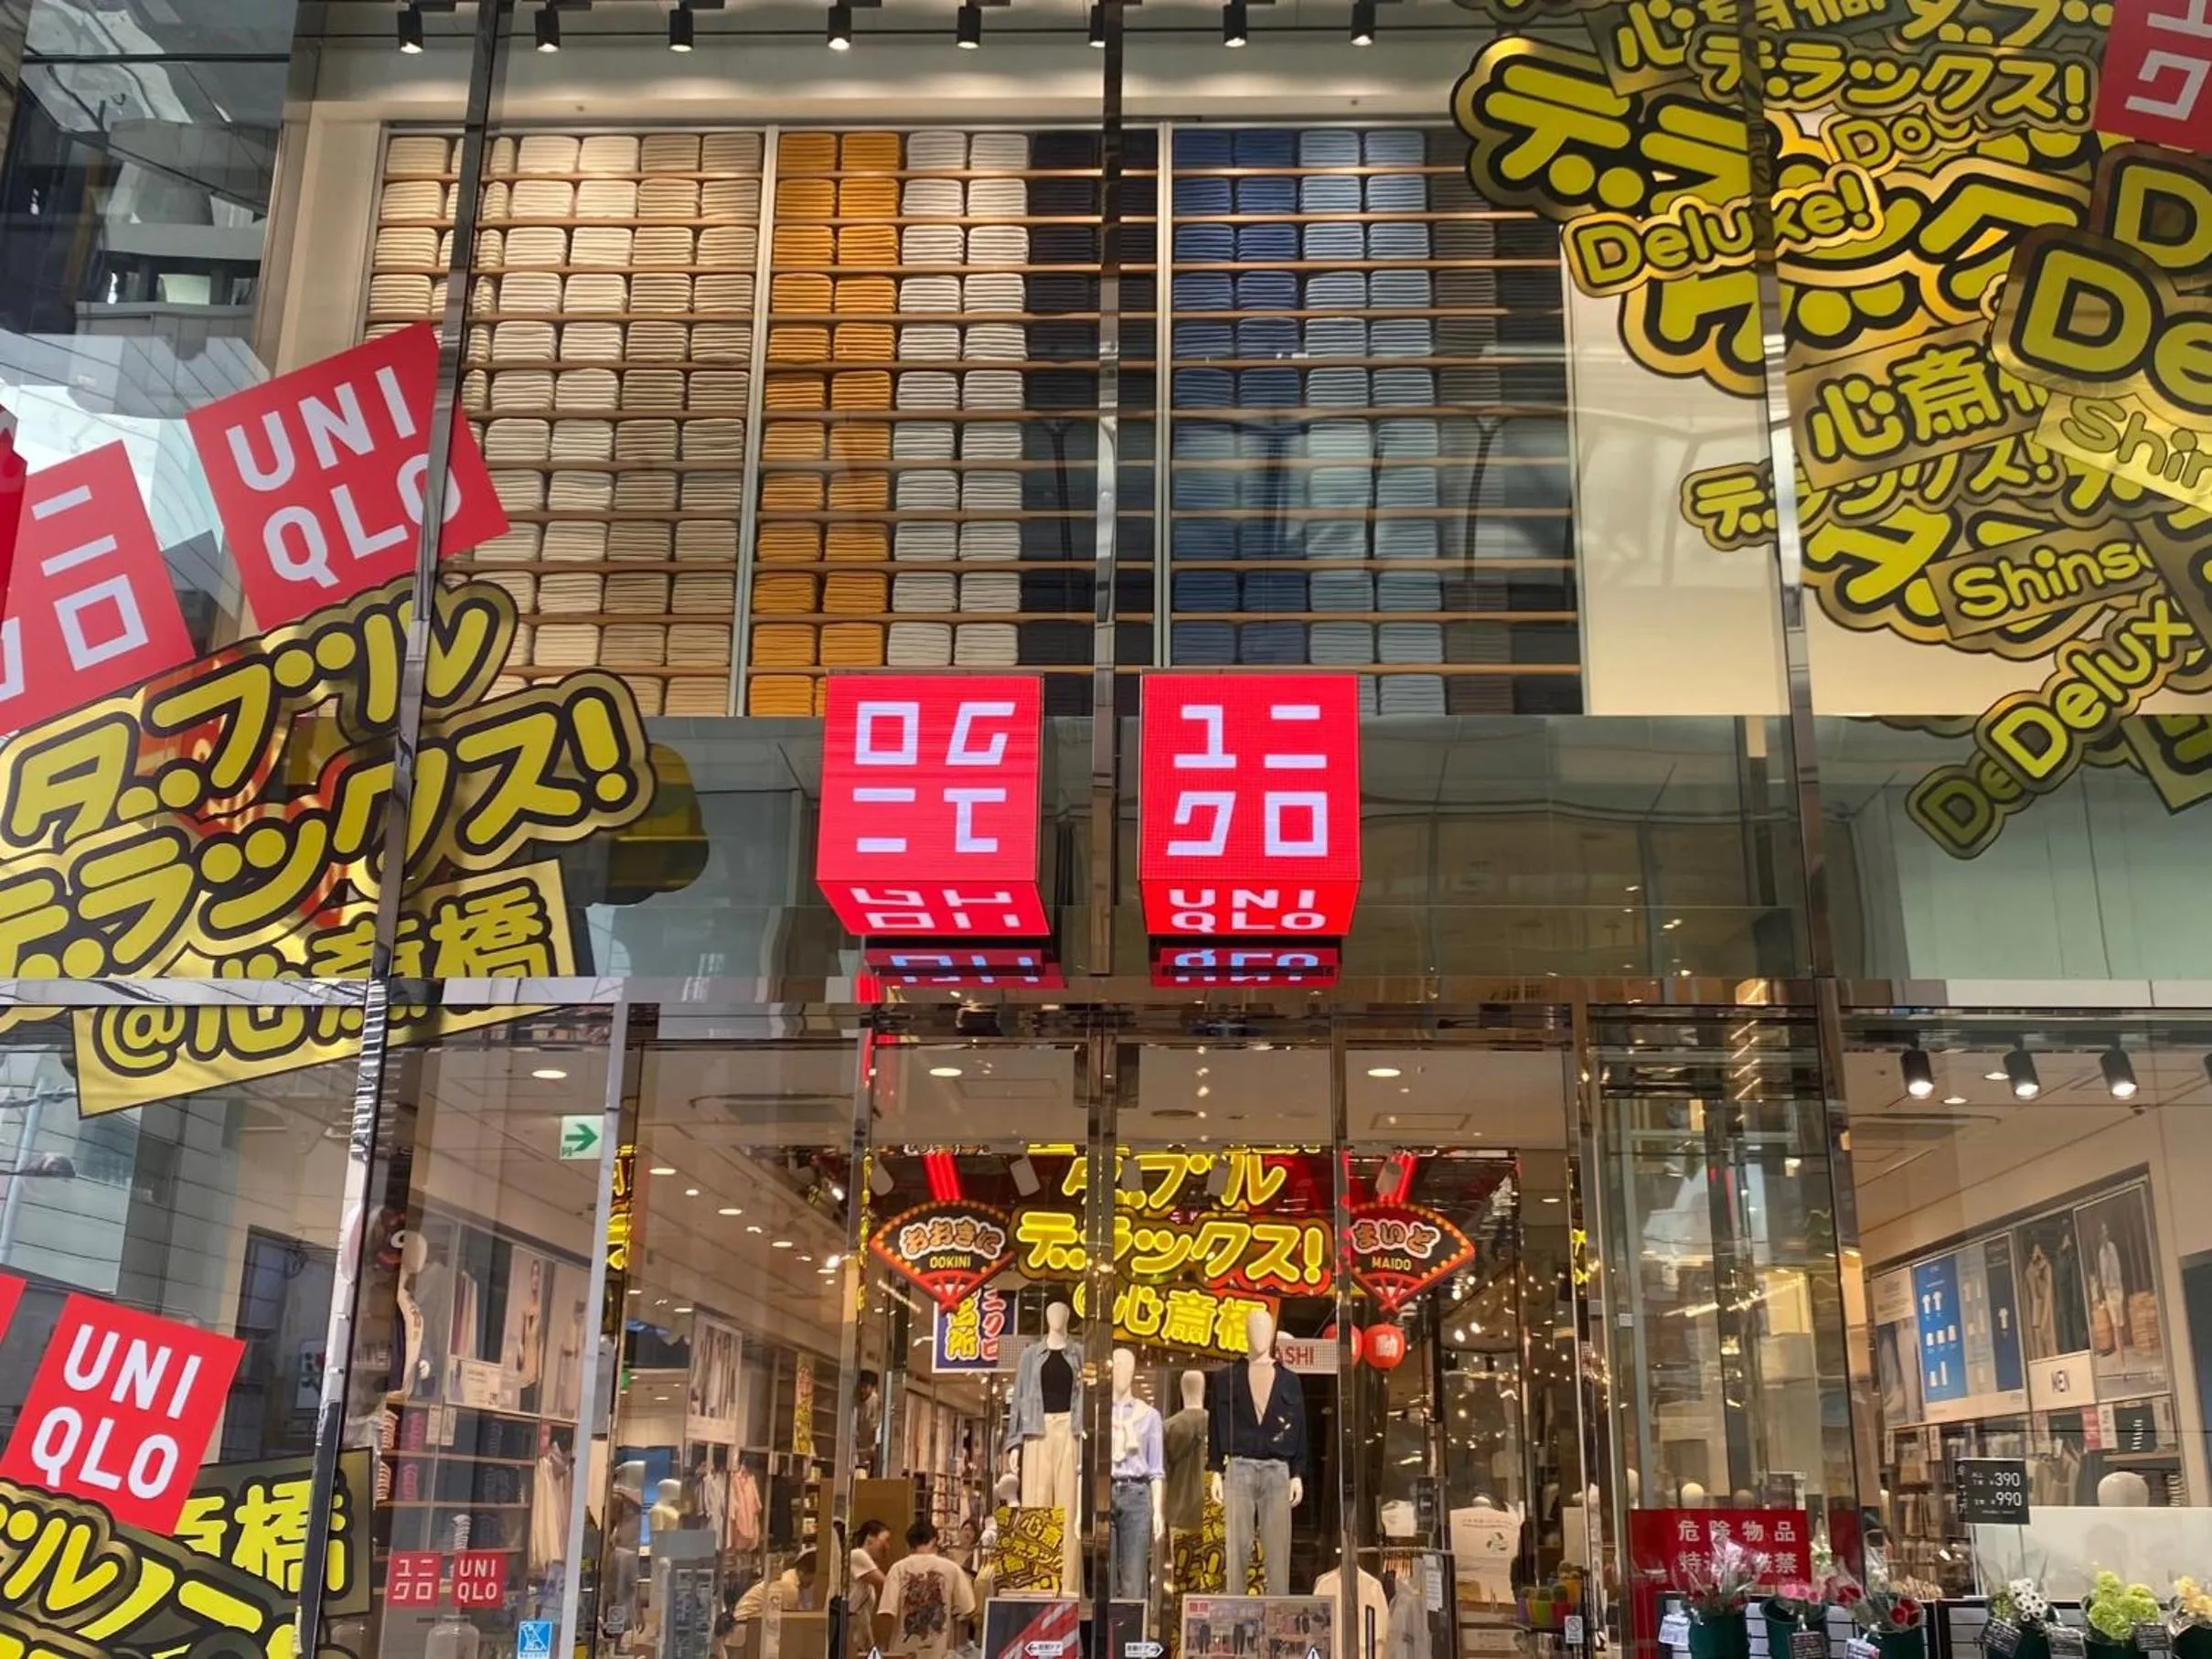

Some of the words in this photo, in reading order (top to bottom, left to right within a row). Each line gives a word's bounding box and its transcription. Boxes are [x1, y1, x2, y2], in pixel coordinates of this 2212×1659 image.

[1576, 171, 1871, 284] Deluxe!
[225, 365, 417, 491] UNI
[262, 453, 461, 588] QLO
[1952, 542, 2154, 618] Shins
[1990, 598, 2194, 778] Delux
[8, 599, 490, 845] ダブル
[1173, 704, 1327, 769] ユニ
[1167, 791, 1329, 858] クロ
[1169, 888, 1317, 910] UNI
[1170, 910, 1327, 934] QLO
[900, 1215, 1005, 1259] おおきに
[929, 1255, 971, 1269] OOKINI
[1016, 1211, 1325, 1285] デラックス!
[1350, 1218, 1441, 1258] まいど
[1371, 1256, 1413, 1271] MAIDO
[63, 1323, 203, 1419] UNI
[31, 1406, 180, 1499] QLO
[1677, 1520, 1797, 1543] 危険物品
[392, 1581, 433, 1600] クロ
[395, 1558, 434, 1578] ユニ
[457, 1581, 497, 1603] QLO
[459, 1559, 497, 1578] UNI
